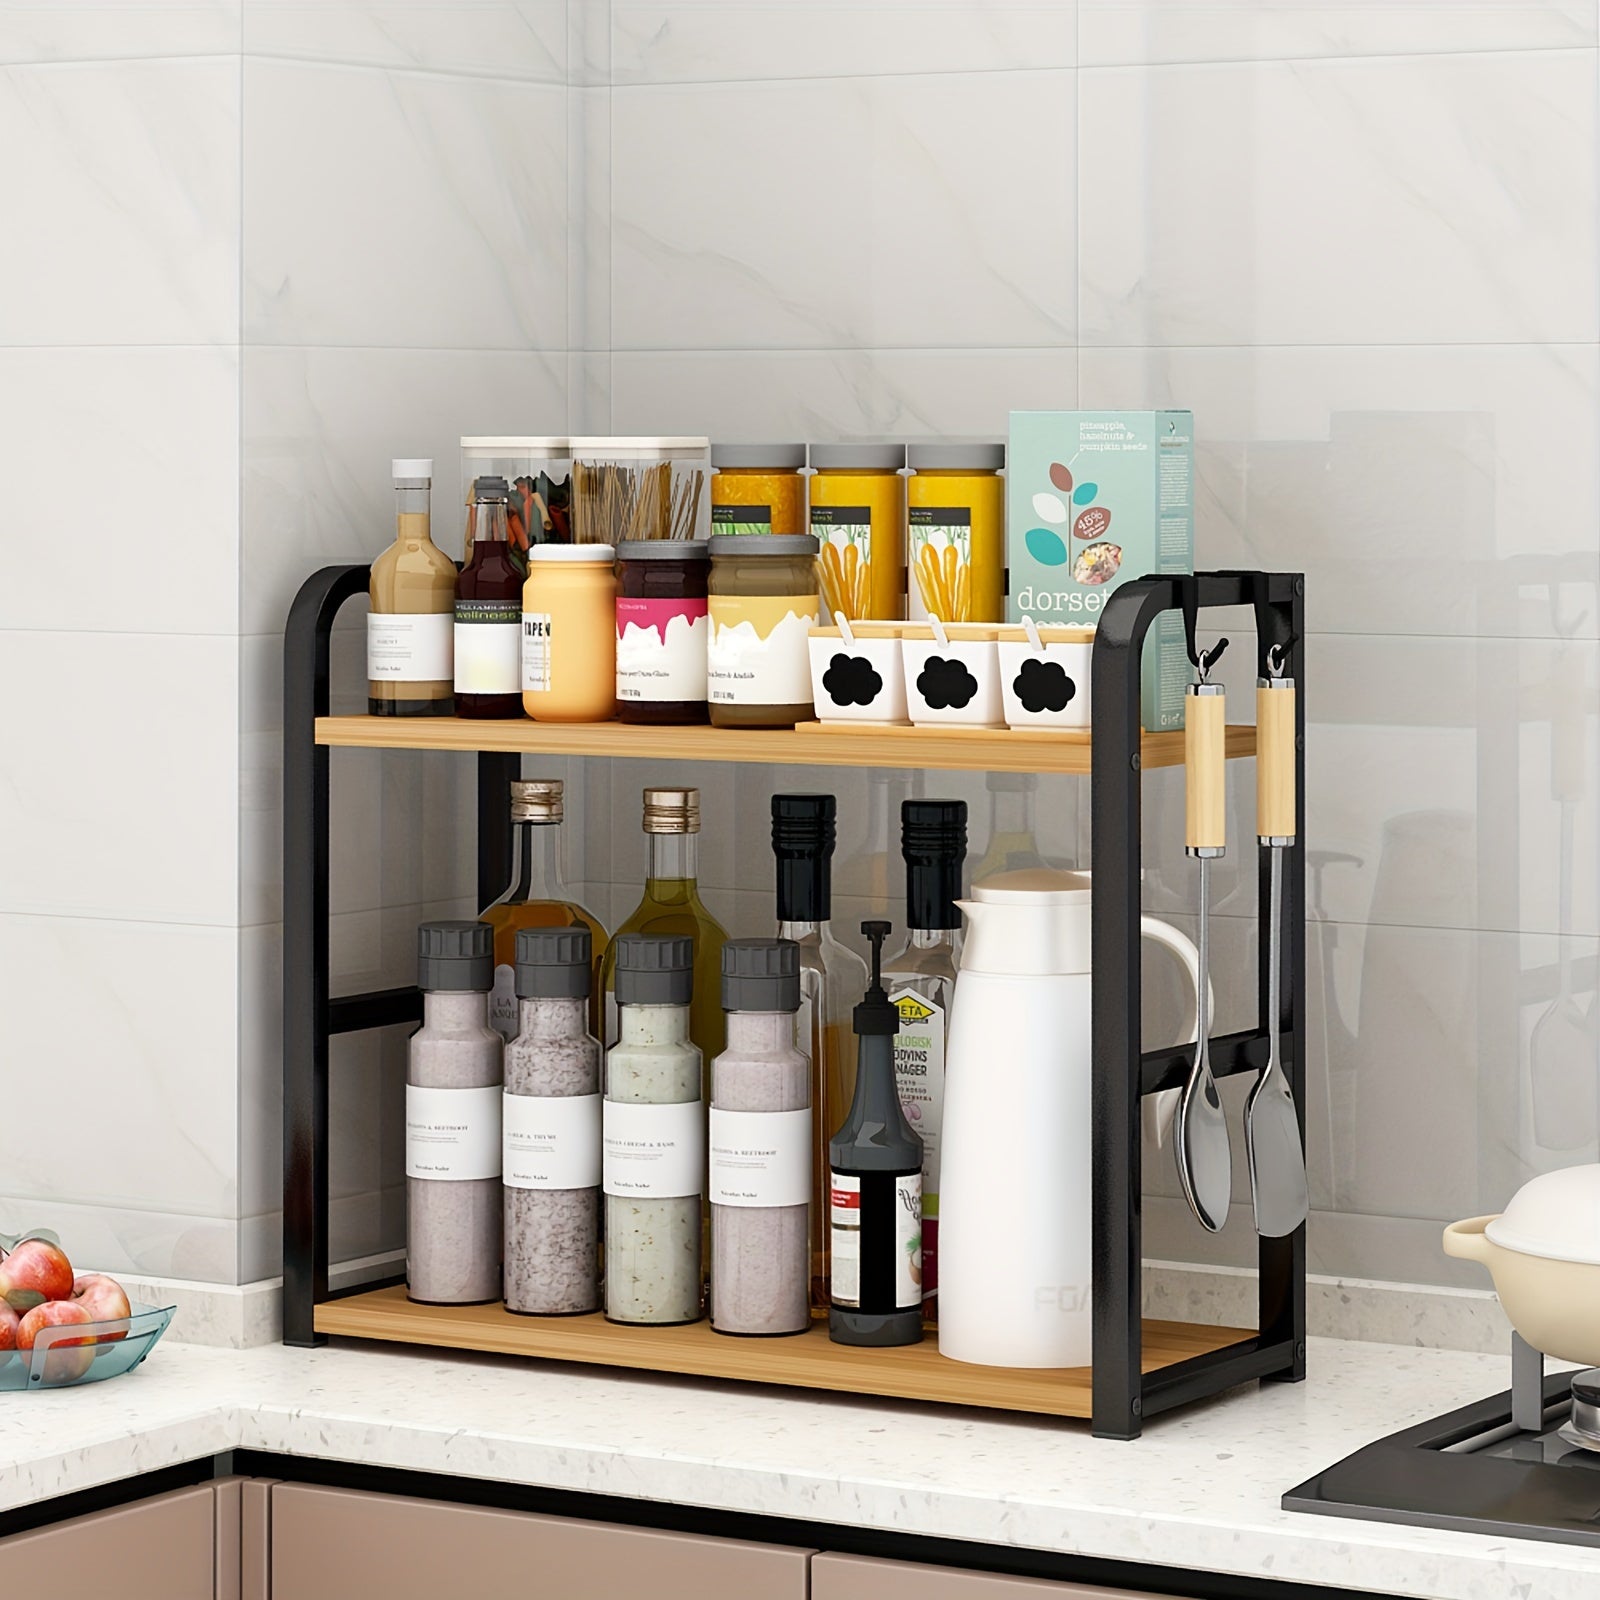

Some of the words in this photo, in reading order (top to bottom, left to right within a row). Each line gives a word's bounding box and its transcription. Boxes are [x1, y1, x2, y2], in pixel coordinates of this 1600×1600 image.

[1017, 586, 1111, 612] dorset
[900, 1004, 923, 1017] ETA
[893, 1034, 932, 1049] OLOGISK
